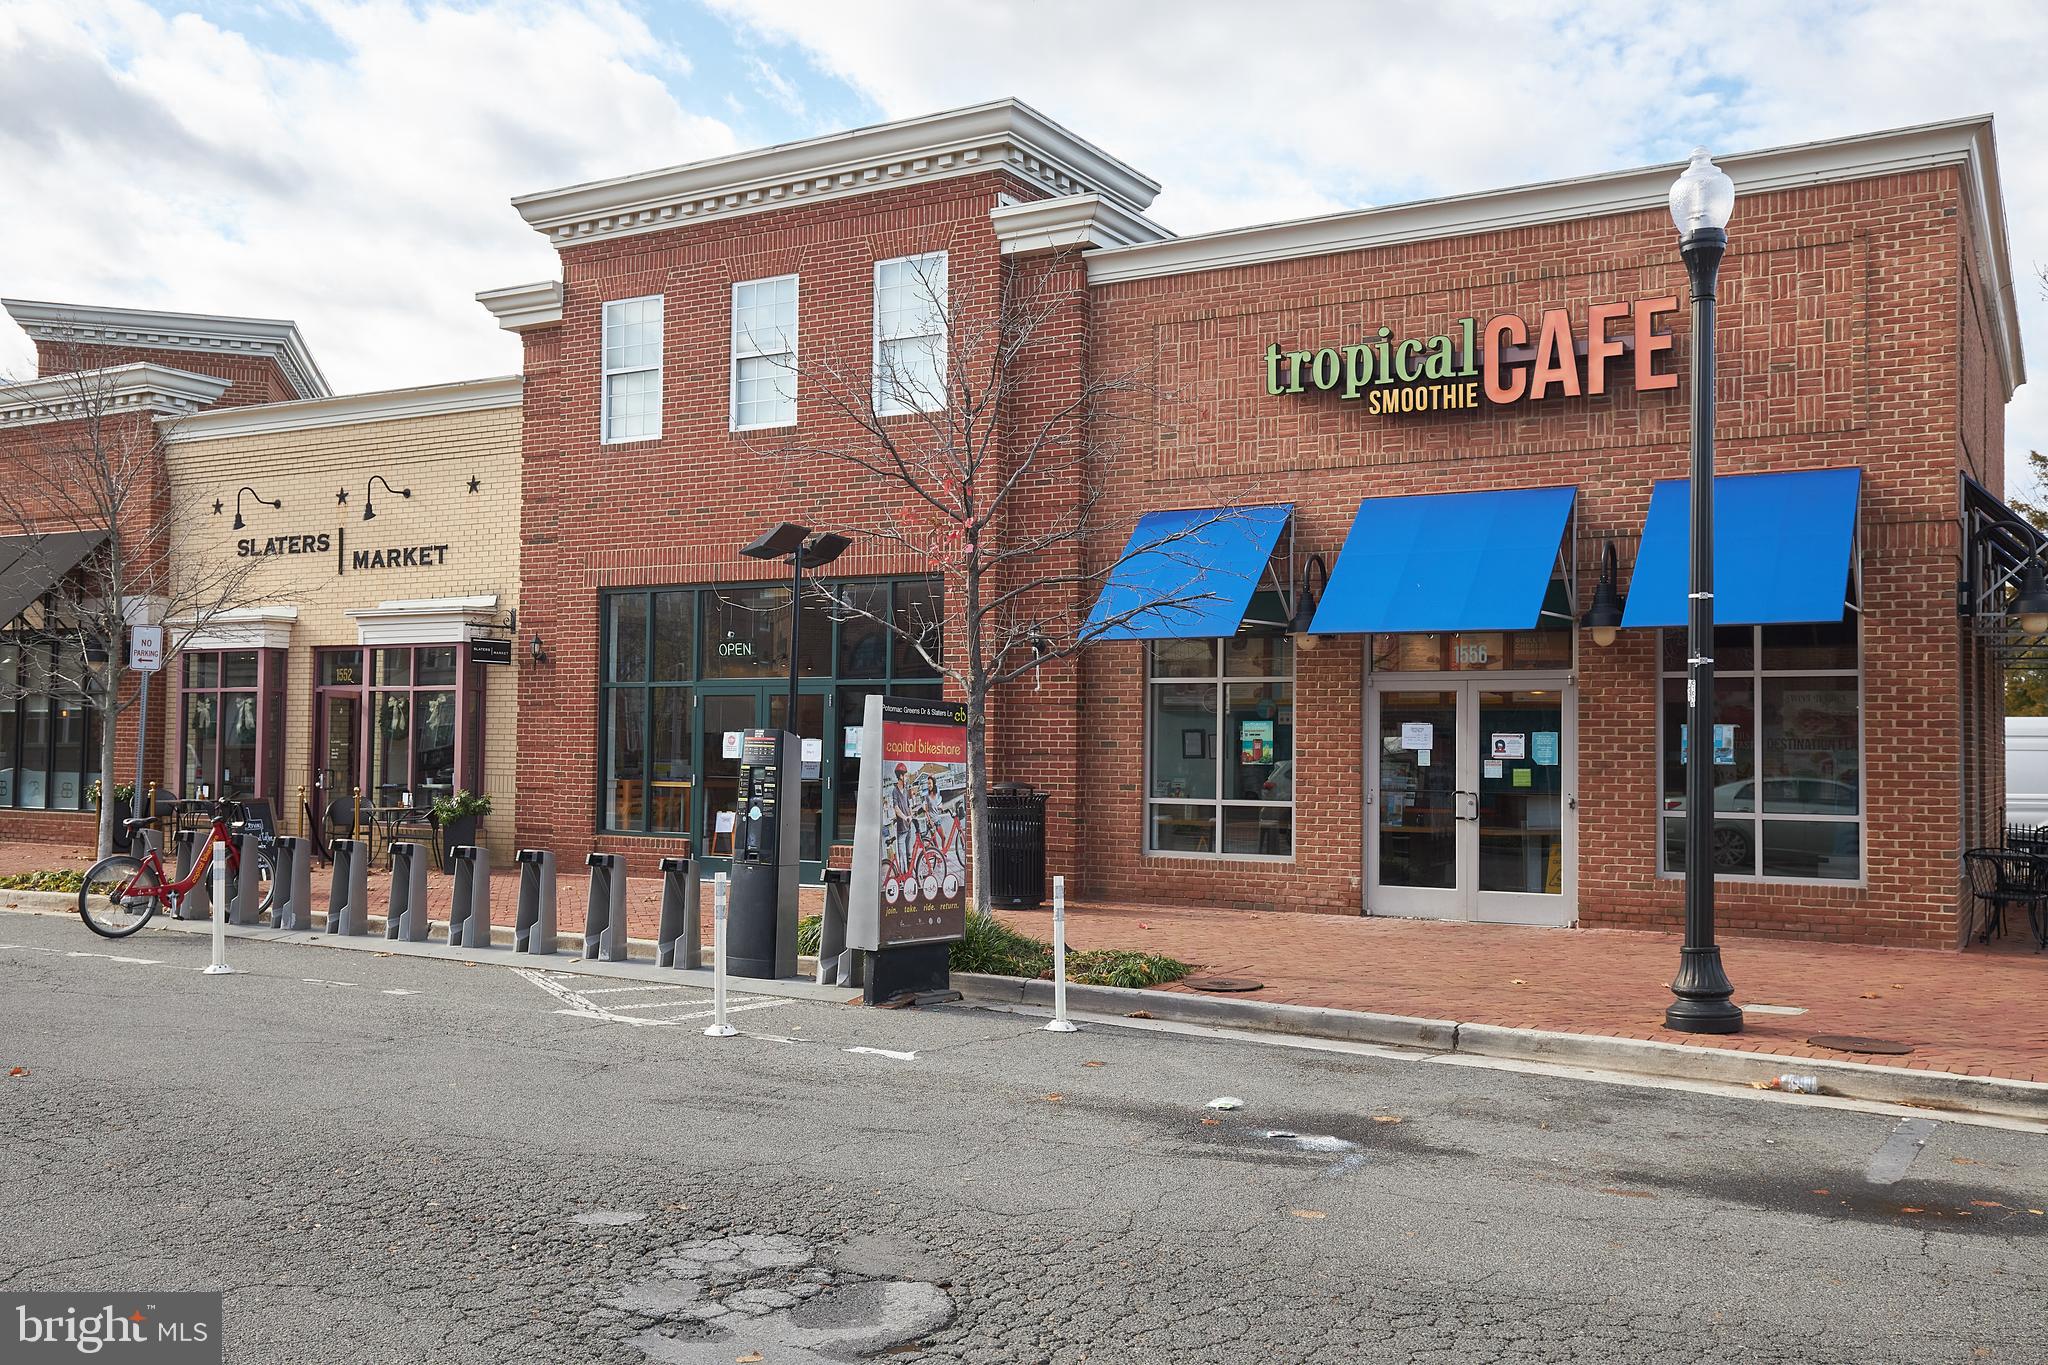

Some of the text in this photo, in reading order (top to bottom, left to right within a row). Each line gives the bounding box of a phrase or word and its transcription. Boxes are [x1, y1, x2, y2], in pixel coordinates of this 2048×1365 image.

[1264, 317, 1479, 399] tropical
[1484, 296, 1680, 405] CAFE
[1368, 382, 1479, 415] SMOOTHIE
[237, 533, 449, 570] SLATERS MARKET
[141, 639, 153, 647] NO
[718, 642, 752, 656] OPEN
[133, 650, 159, 658] PARKING
[1454, 644, 1488, 664] 1556
[335, 668, 353, 681] 1552
[882, 703, 903, 714] Potomac
[903, 705, 921, 715] Greens
[920, 707, 927, 715] Dr
[926, 707, 932, 715] &
[931, 708, 947, 717] Slaters
[886, 738, 961, 757] capital bikeshare
